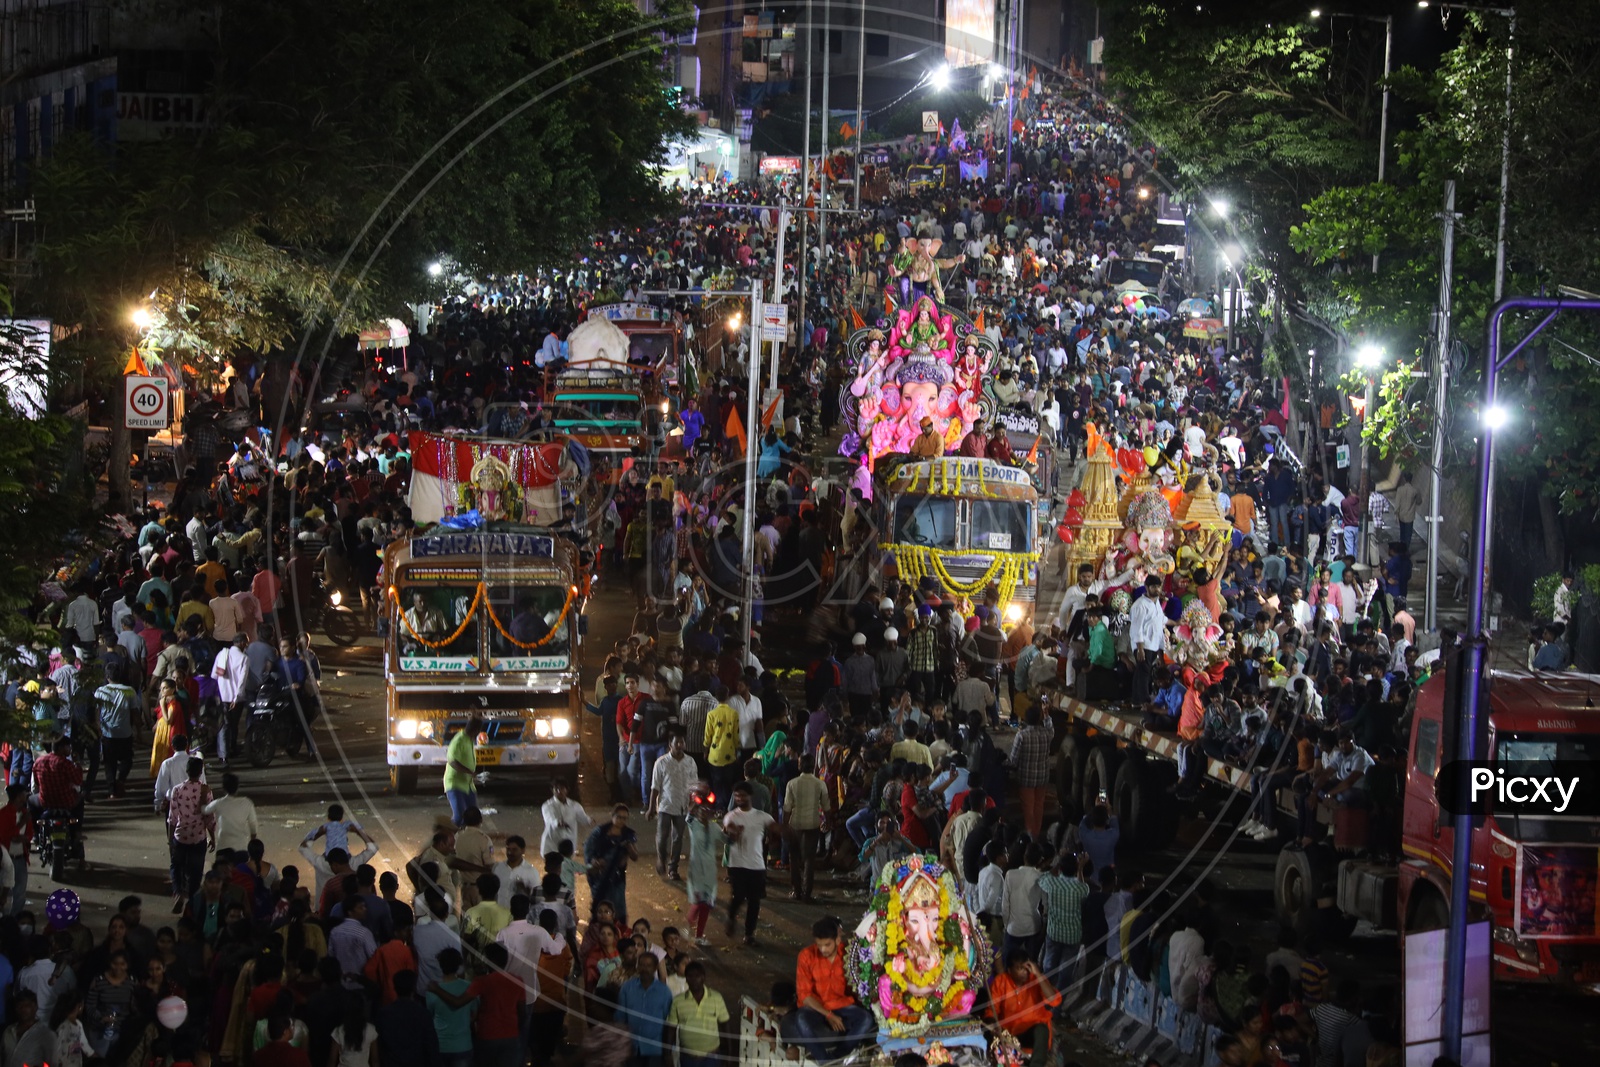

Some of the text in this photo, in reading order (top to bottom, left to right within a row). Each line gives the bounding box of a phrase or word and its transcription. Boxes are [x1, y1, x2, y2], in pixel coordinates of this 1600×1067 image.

[137, 393, 156, 407] 40
[128, 418, 165, 427] SPEED LIMIT
[951, 463, 1021, 483] TRANSPORT
[427, 534, 534, 556] SARAVANA
[481, 710, 518, 719] LEYLAND
